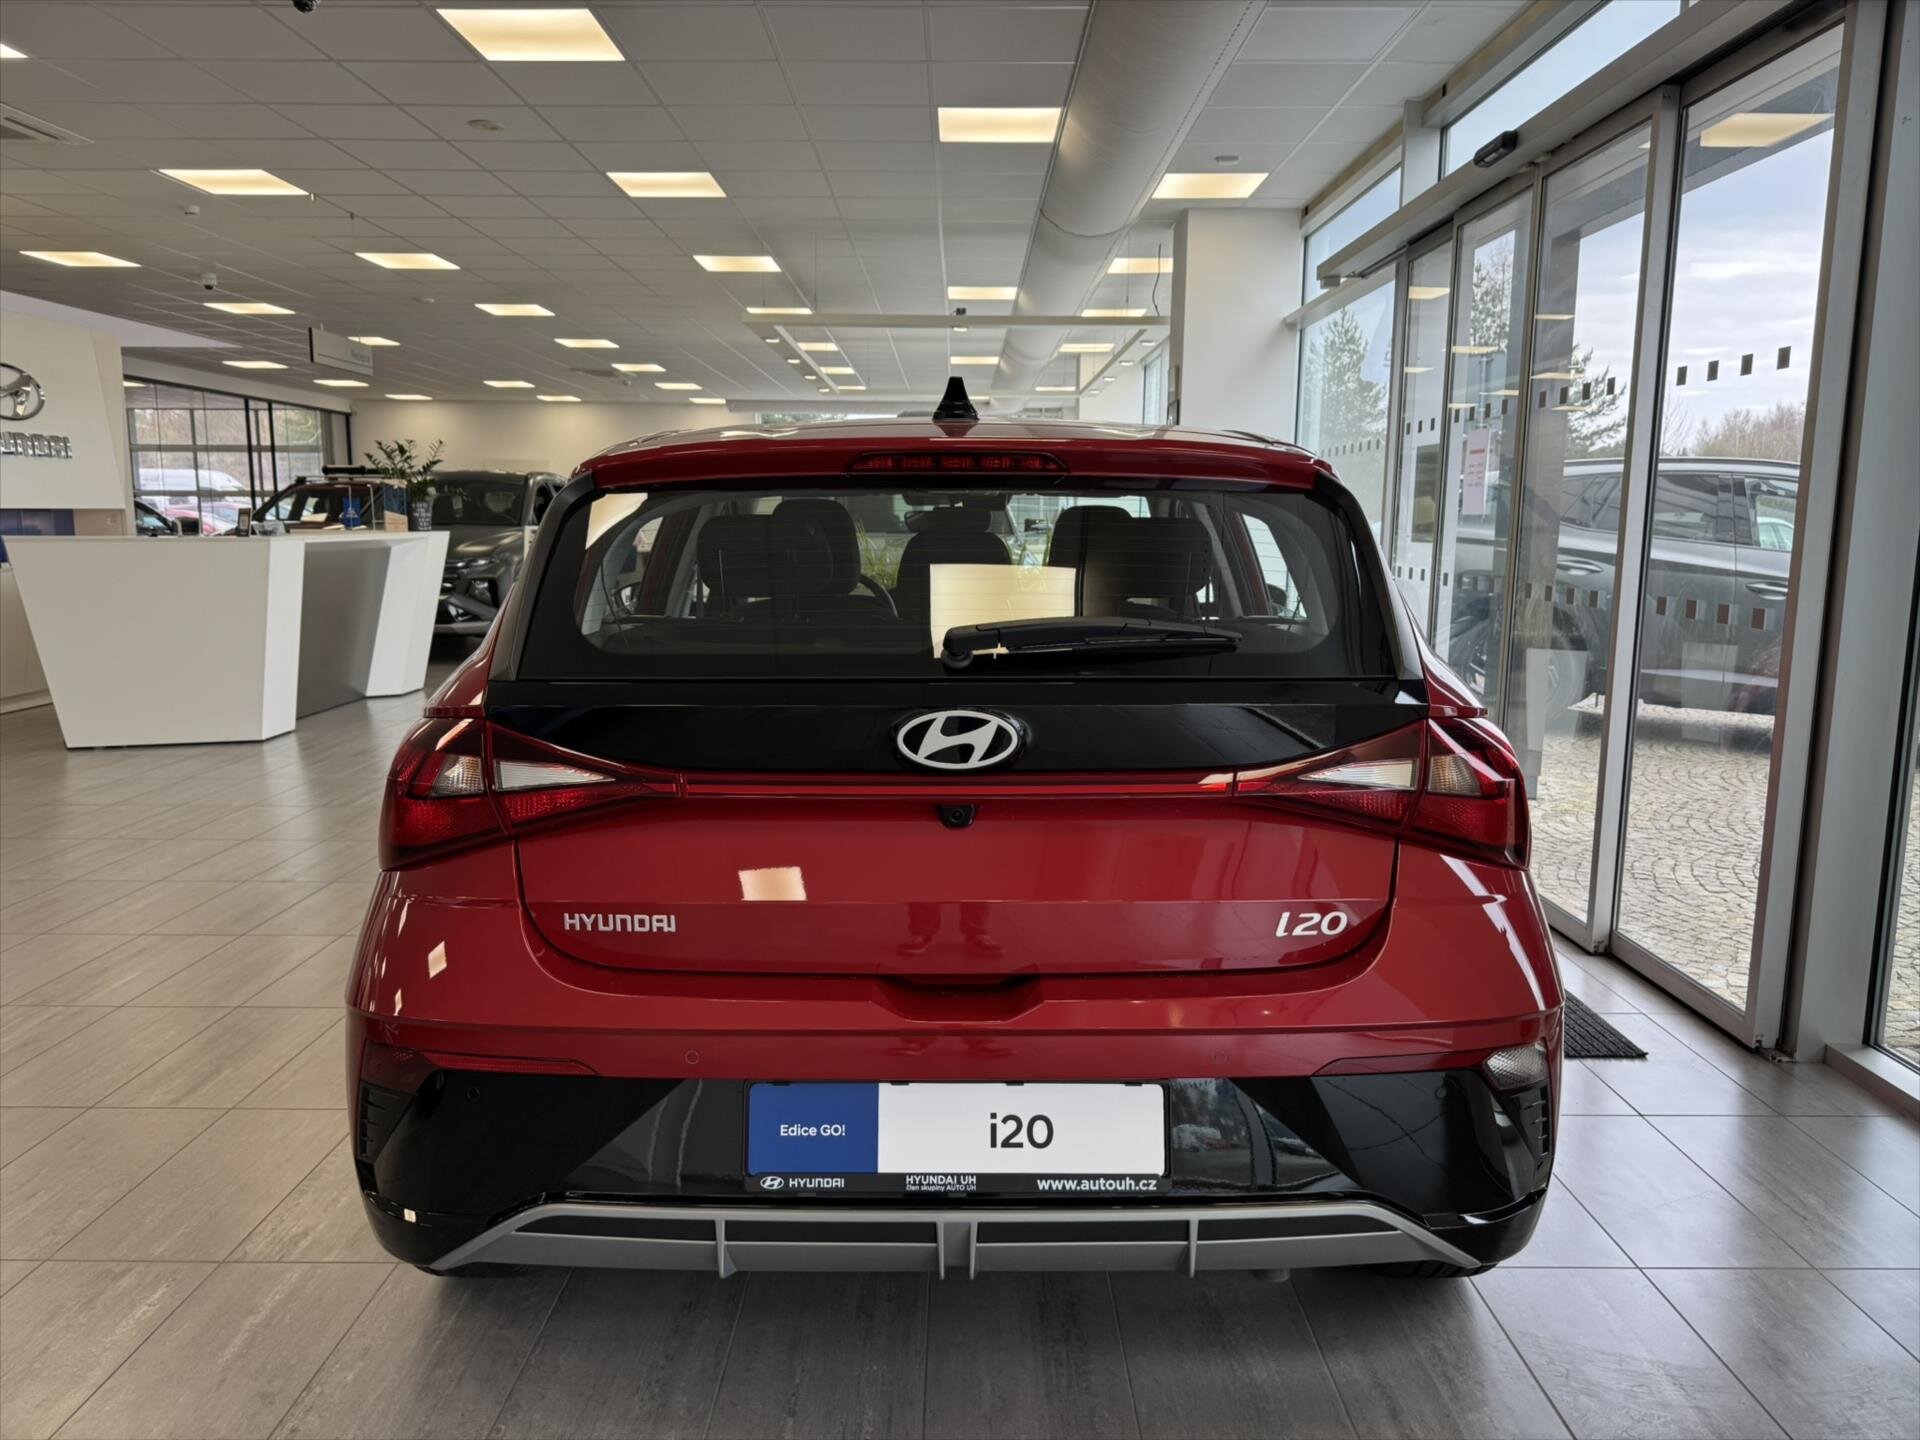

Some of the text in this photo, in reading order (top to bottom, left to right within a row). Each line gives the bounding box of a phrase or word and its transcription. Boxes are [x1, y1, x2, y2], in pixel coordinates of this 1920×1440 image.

[0, 431, 72, 459] UNDAI
[564, 912, 676, 933] HYUNDAI
[780, 1123, 846, 1137] Edice GO!
[990, 1112, 1054, 1149] i20
[789, 1177, 845, 1188] HYUNDAI
[906, 1175, 977, 1185] HYUNDAI UH
[1037, 1176, 1157, 1191] www.autouh.cz
[921, 1184, 946, 1192] skupiny
